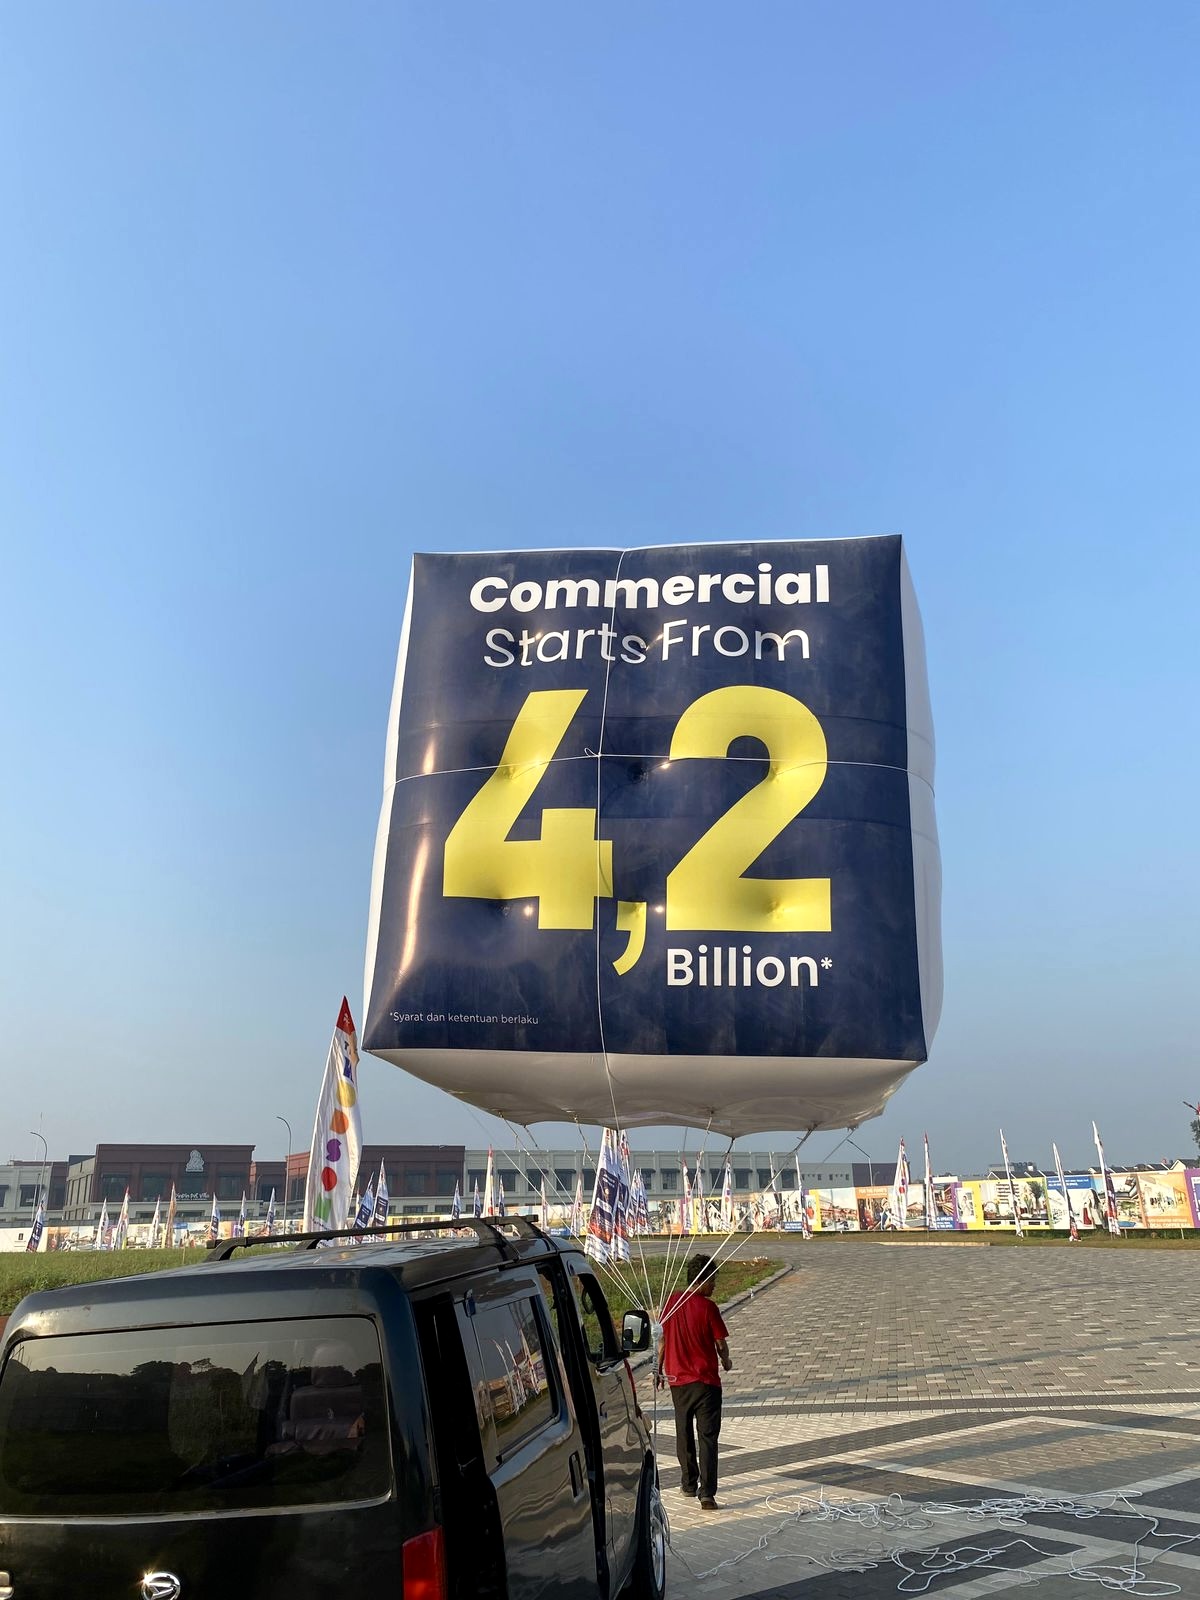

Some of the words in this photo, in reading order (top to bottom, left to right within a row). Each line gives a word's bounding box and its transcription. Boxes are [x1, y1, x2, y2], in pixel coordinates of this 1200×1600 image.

[469, 562, 830, 613] Commercial
[484, 622, 648, 668] Starts
[661, 618, 810, 662] From
[443, 685, 832, 976] 4,2
[426, 1012, 446, 1022] dan
[448, 1012, 498, 1023] ketentuan
[501, 1013, 539, 1025] berlaku
